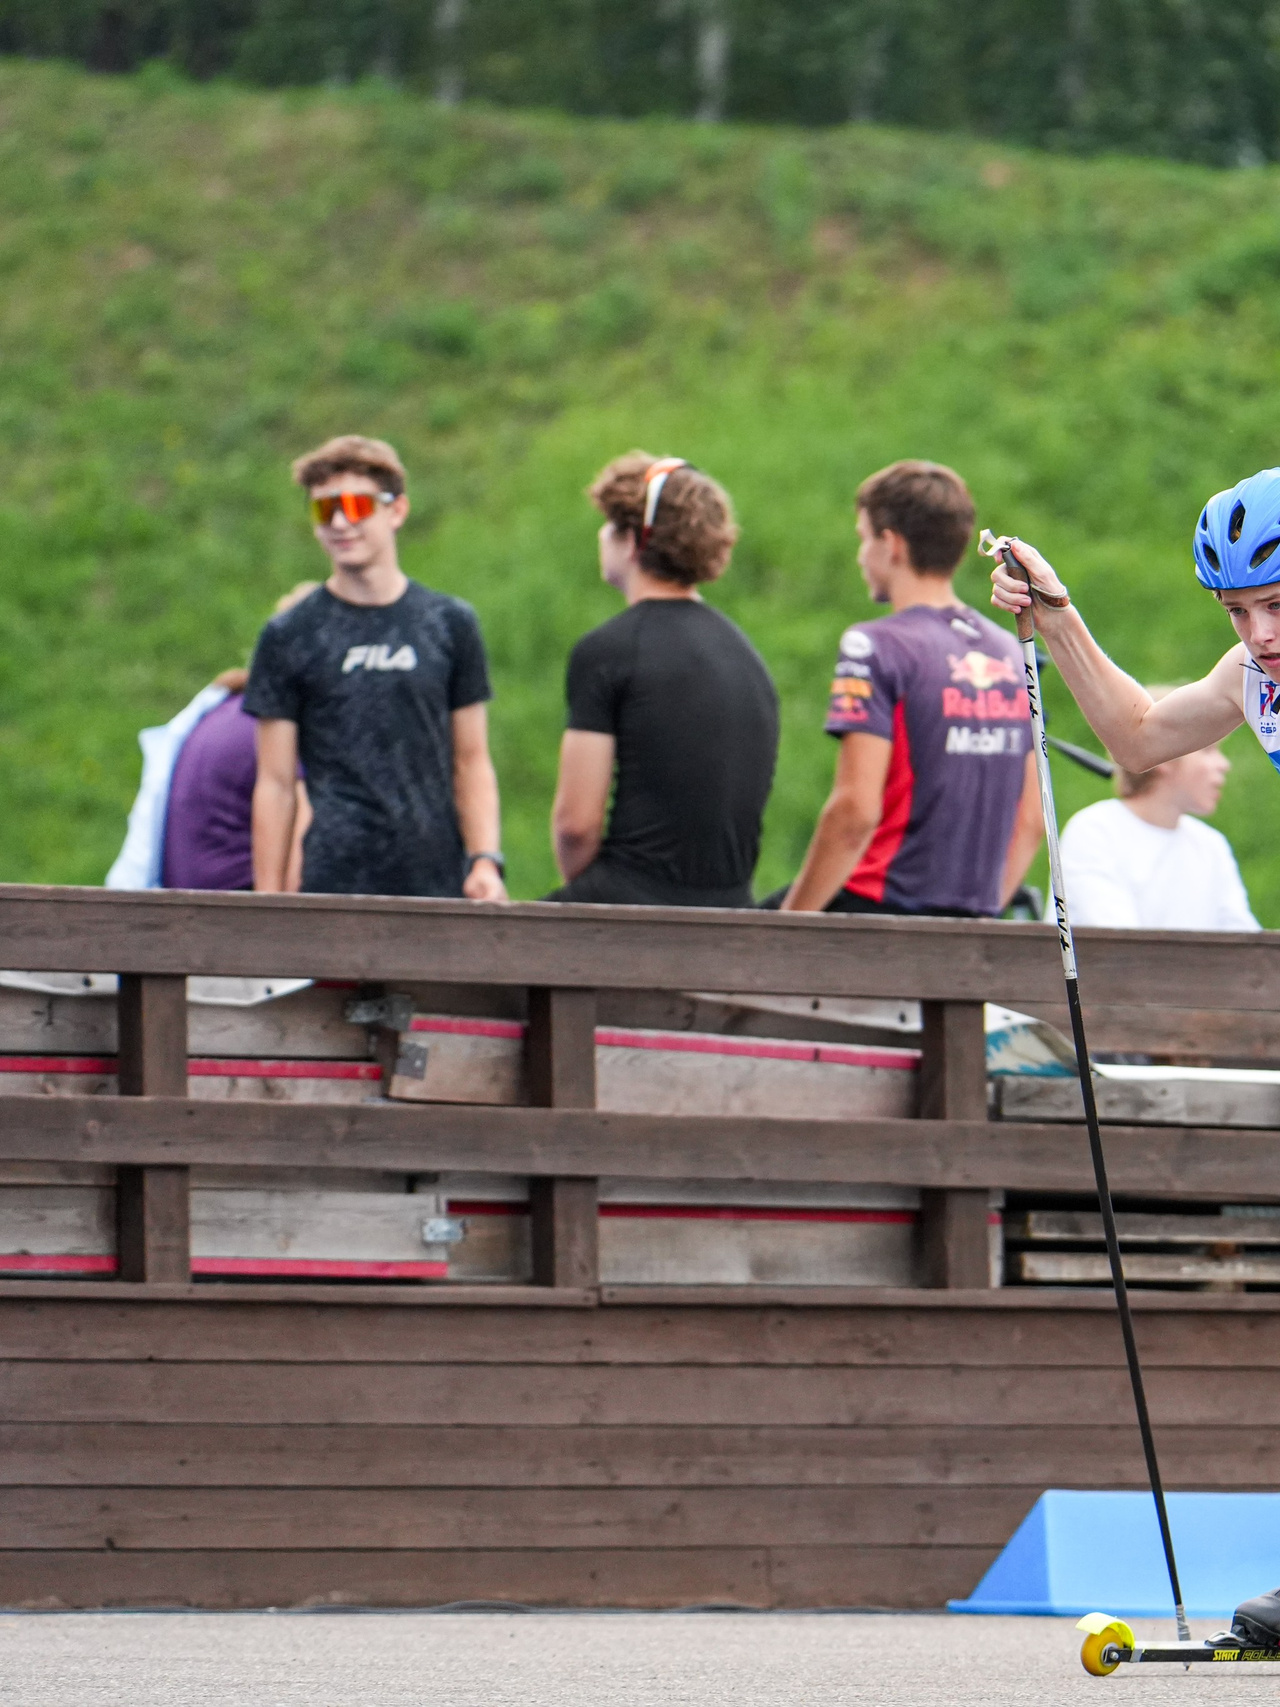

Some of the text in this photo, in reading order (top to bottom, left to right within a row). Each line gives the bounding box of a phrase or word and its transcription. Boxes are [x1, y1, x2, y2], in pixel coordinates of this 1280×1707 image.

[341, 643, 418, 674] FILA
[945, 726, 1004, 755] Mobil
[1009, 727, 1022, 754] 1
[1213, 1649, 1240, 1661] START
